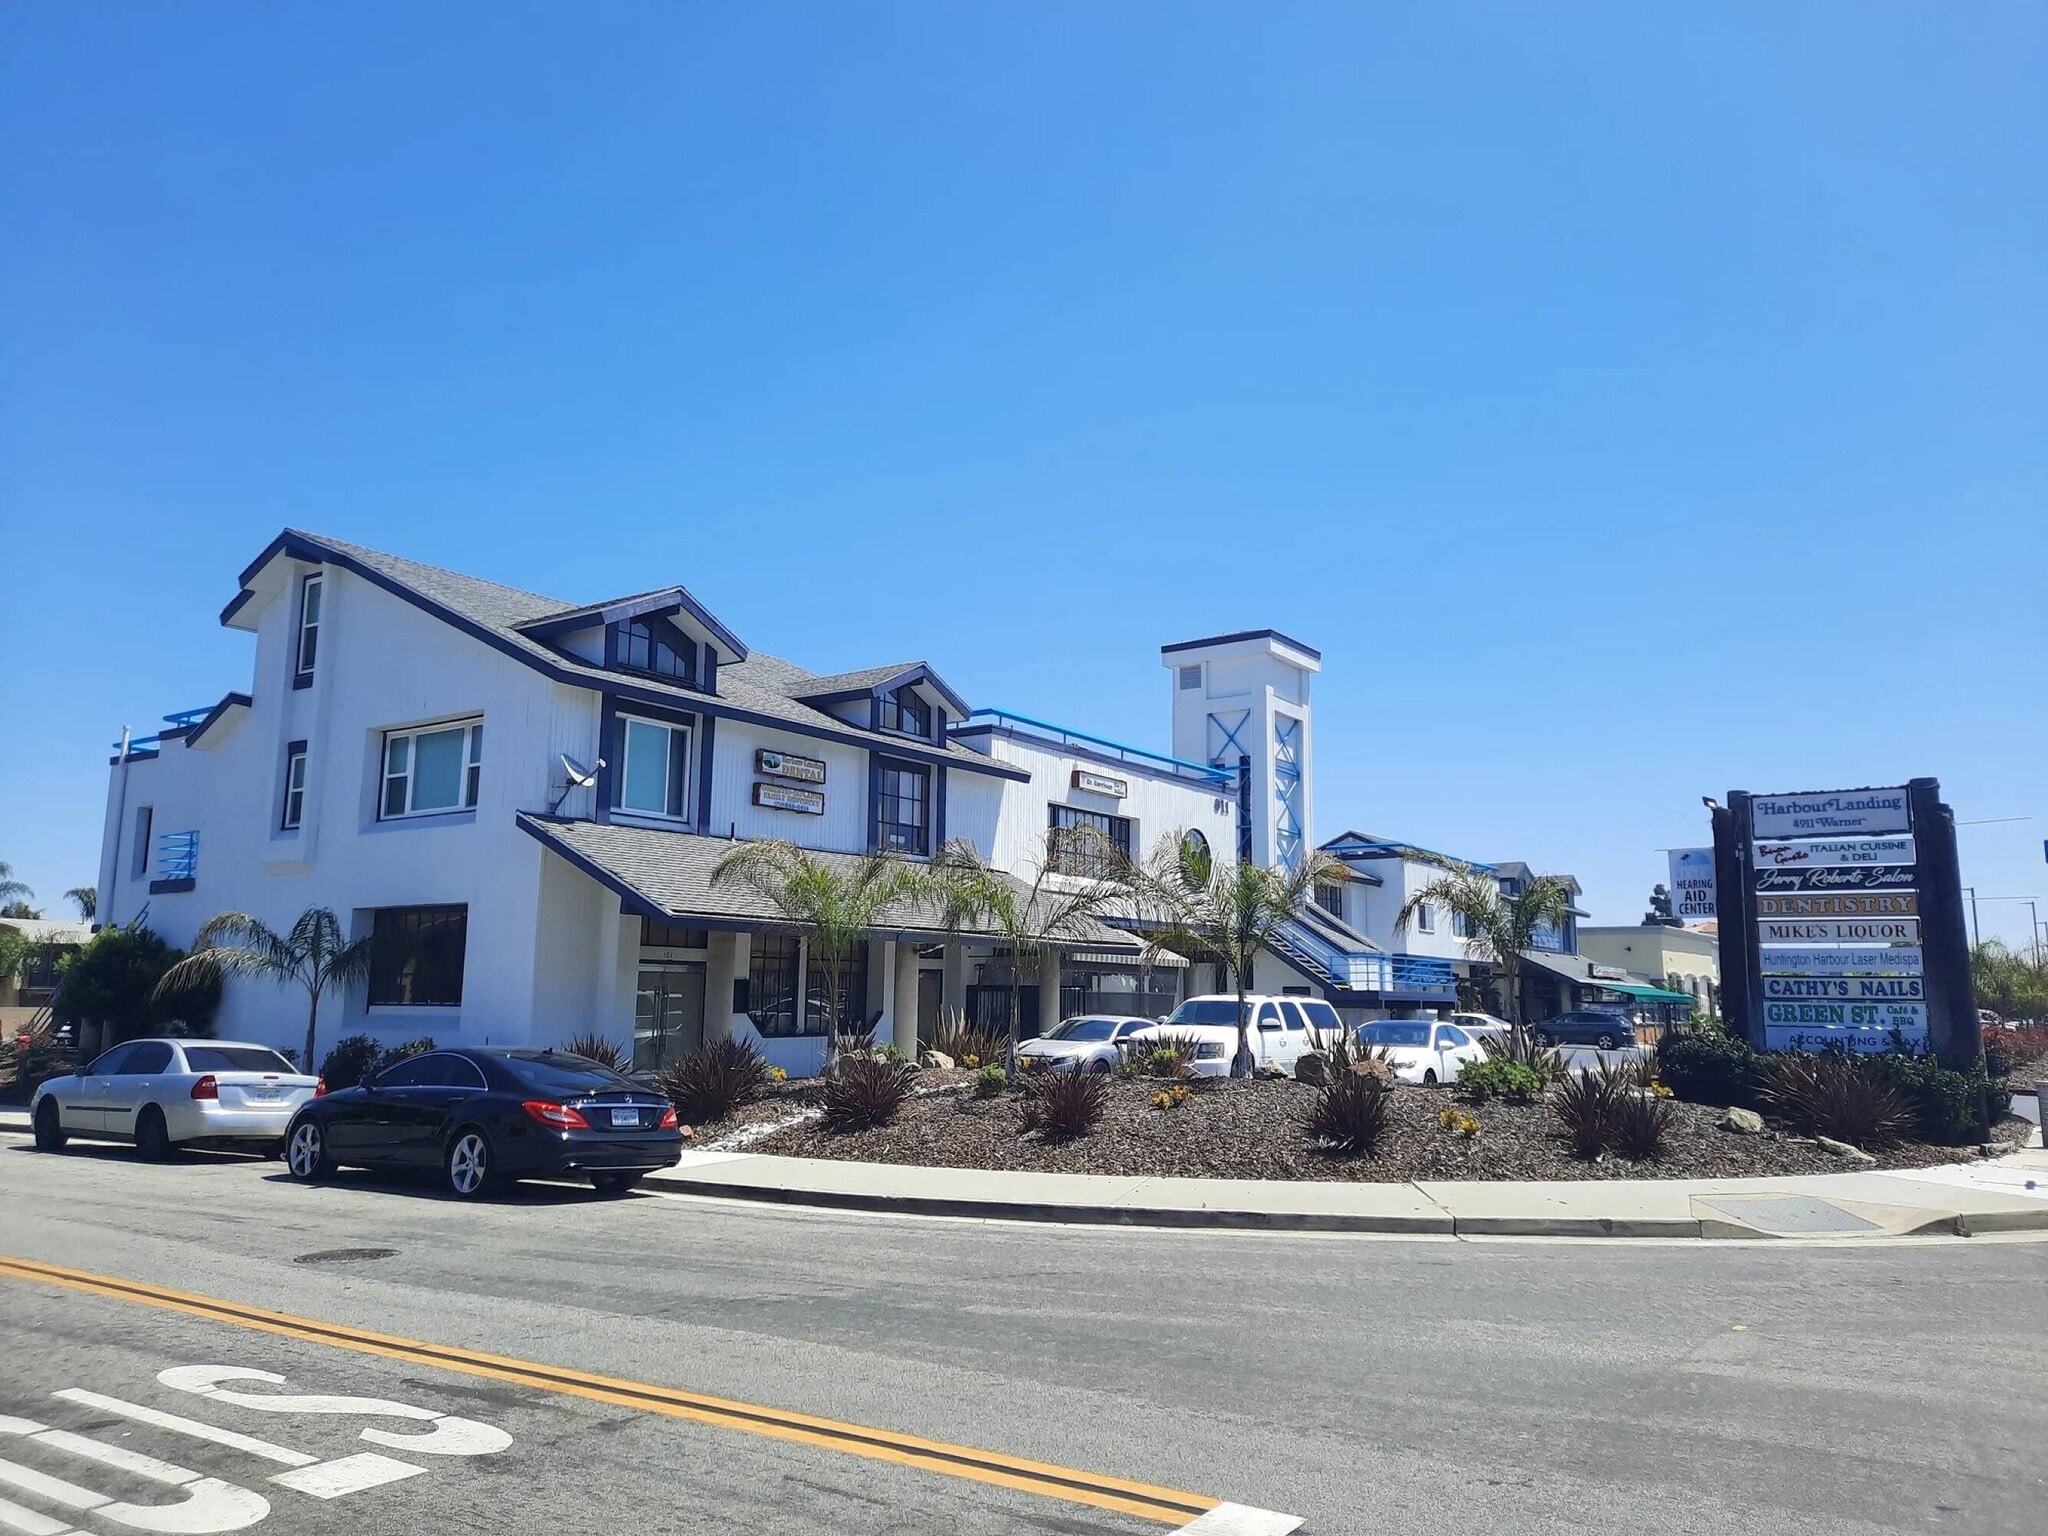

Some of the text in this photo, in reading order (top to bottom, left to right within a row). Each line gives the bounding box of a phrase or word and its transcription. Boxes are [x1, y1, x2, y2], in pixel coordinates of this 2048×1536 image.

[1757, 796, 1902, 815] Harbour Landing
[1793, 816, 1867, 829] 4911 Warner
[1810, 841, 1907, 853] ITALIAN CUISINE
[1851, 852, 1878, 861] DELI
[1676, 879, 1713, 890] HEARING
[1757, 867, 1915, 891] Jerry Roberts Salon
[1684, 890, 1707, 902] AID
[1679, 902, 1715, 915] CENTER
[1760, 895, 1914, 914] DENTISTRY
[1768, 925, 1907, 939] MIKE'S LIQUOR
[1763, 952, 1919, 968] Huntington Harbour Laser Medispa
[1768, 980, 1920, 996] CATHY'S NAILS
[1767, 1004, 1919, 1024] GREEN ST. Café &
[1892, 1017, 1915, 1026] BBQ
[1881, 1038, 1889, 1047] &
[1899, 1037, 1922, 1048] AX
[0, 1364, 514, 1536] STO
